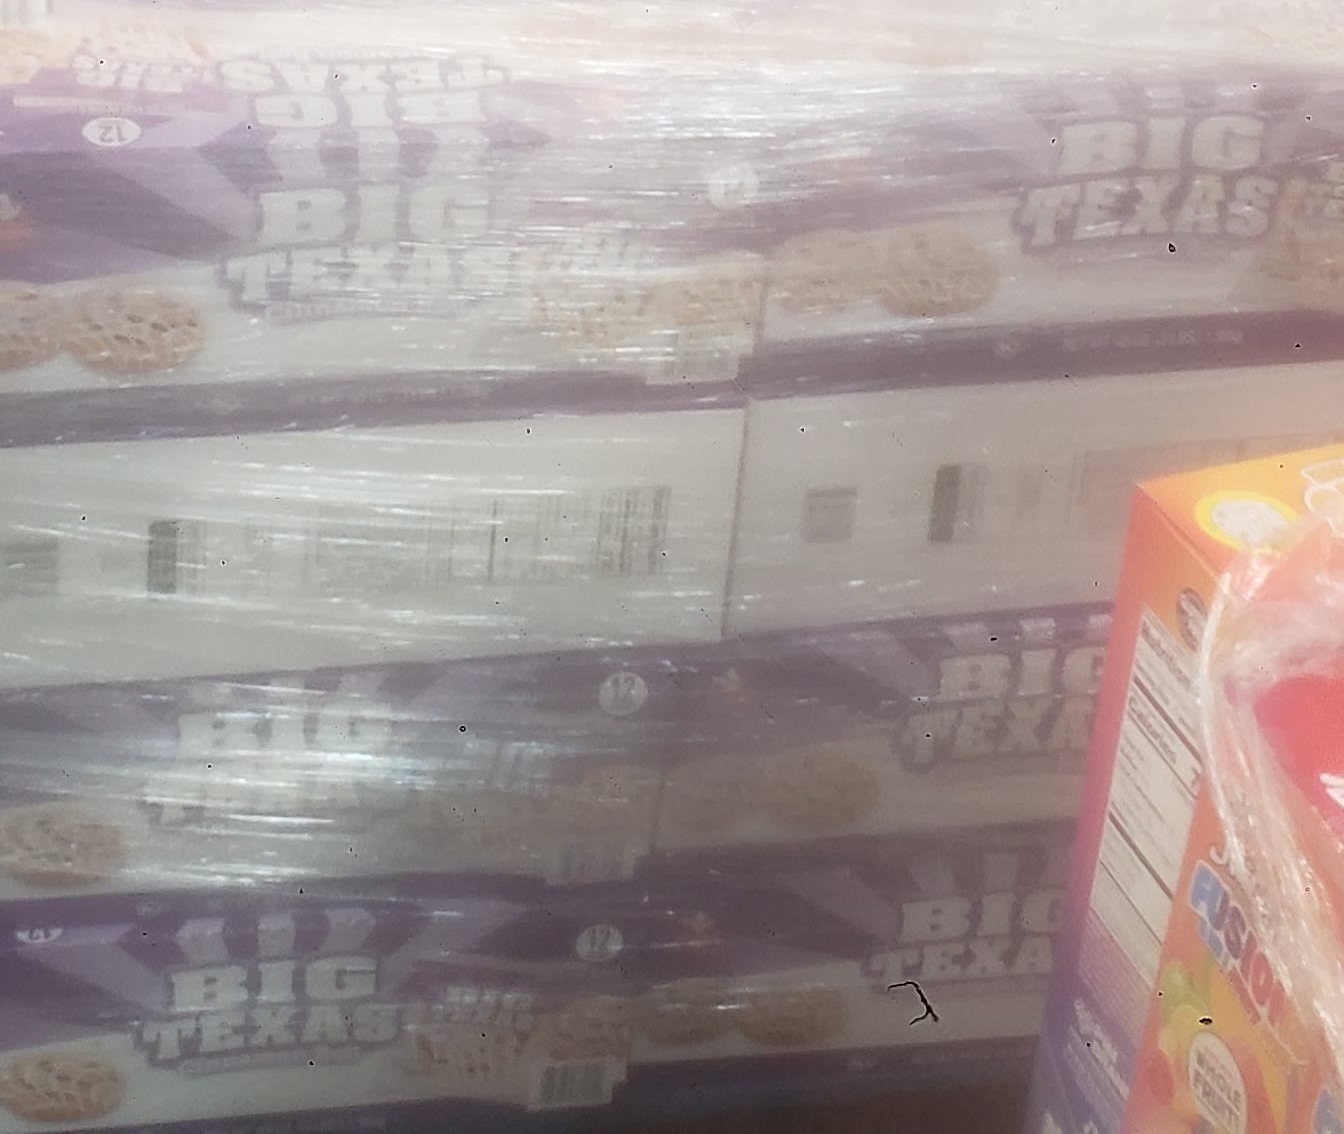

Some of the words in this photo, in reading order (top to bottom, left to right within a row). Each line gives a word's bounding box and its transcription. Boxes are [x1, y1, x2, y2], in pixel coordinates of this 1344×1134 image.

[1058, 116, 1265, 177] BIG
[259, 185, 494, 243] BIG
[1022, 174, 1278, 248] TEXAS
[610, 675, 637, 701] 12
[170, 955, 379, 1015] BIG
[141, 1003, 401, 1062] TEXAS
